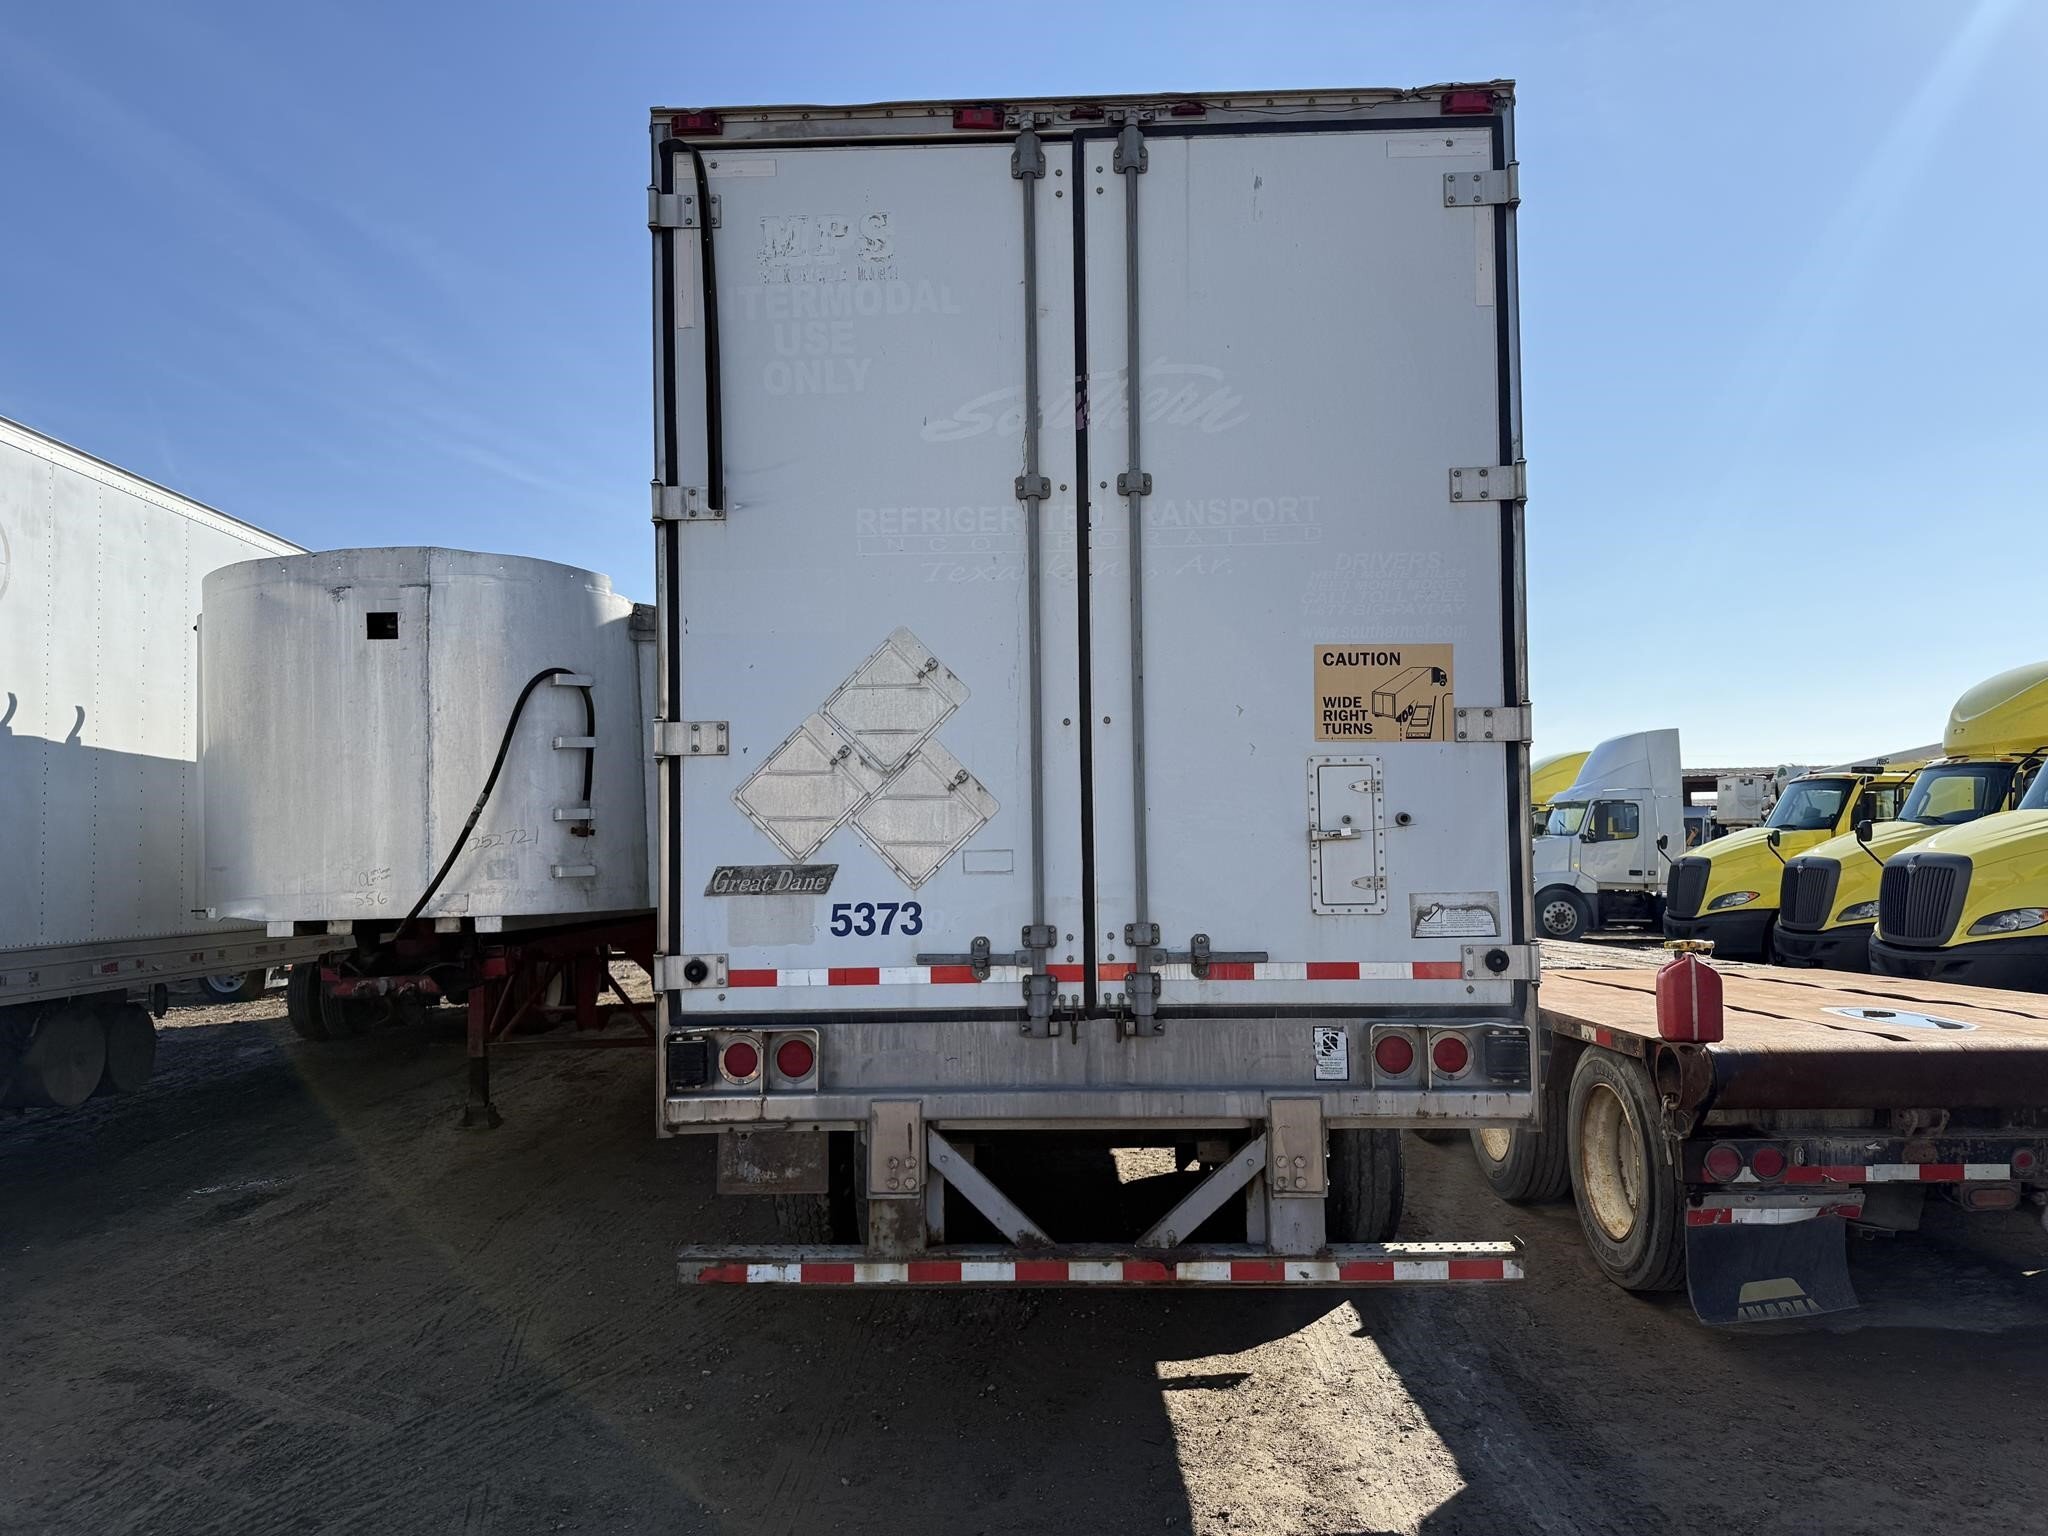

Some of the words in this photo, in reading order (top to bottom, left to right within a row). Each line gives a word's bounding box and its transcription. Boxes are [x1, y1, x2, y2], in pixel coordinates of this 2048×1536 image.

[773, 320, 856, 357] USE
[763, 357, 873, 396] ONLY
[1143, 496, 1321, 528] RANSPORT
[1322, 652, 1401, 666] CAUTION
[1322, 696, 1362, 708] WIDE
[1323, 709, 1368, 722] RIGHT
[1322, 722, 1373, 735] TURNS
[712, 869, 773, 893] Great
[772, 869, 828, 892] Dane
[830, 901, 923, 937] 5373
